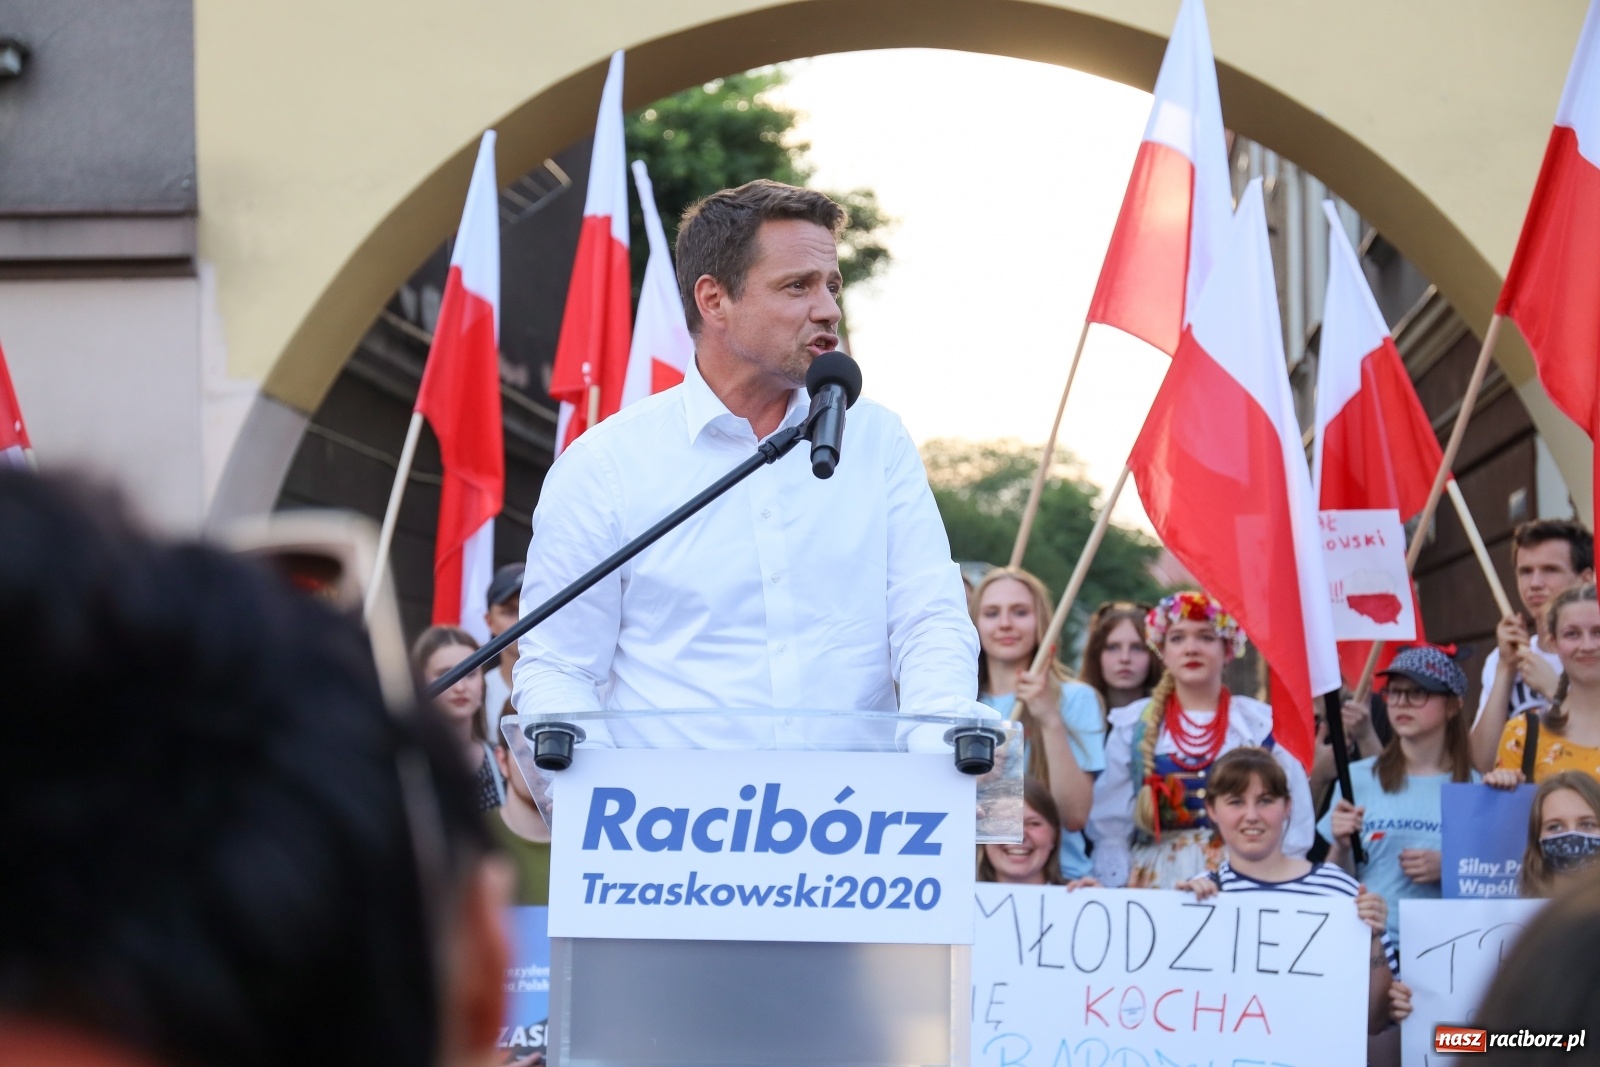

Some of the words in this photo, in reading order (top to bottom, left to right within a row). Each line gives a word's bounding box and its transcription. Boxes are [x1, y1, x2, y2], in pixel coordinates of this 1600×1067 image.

[582, 783, 949, 856] Racibórz
[1458, 857, 1502, 878] Silny
[582, 871, 942, 911] Trzaskowski2020
[1084, 985, 1272, 1035] KOCHA
